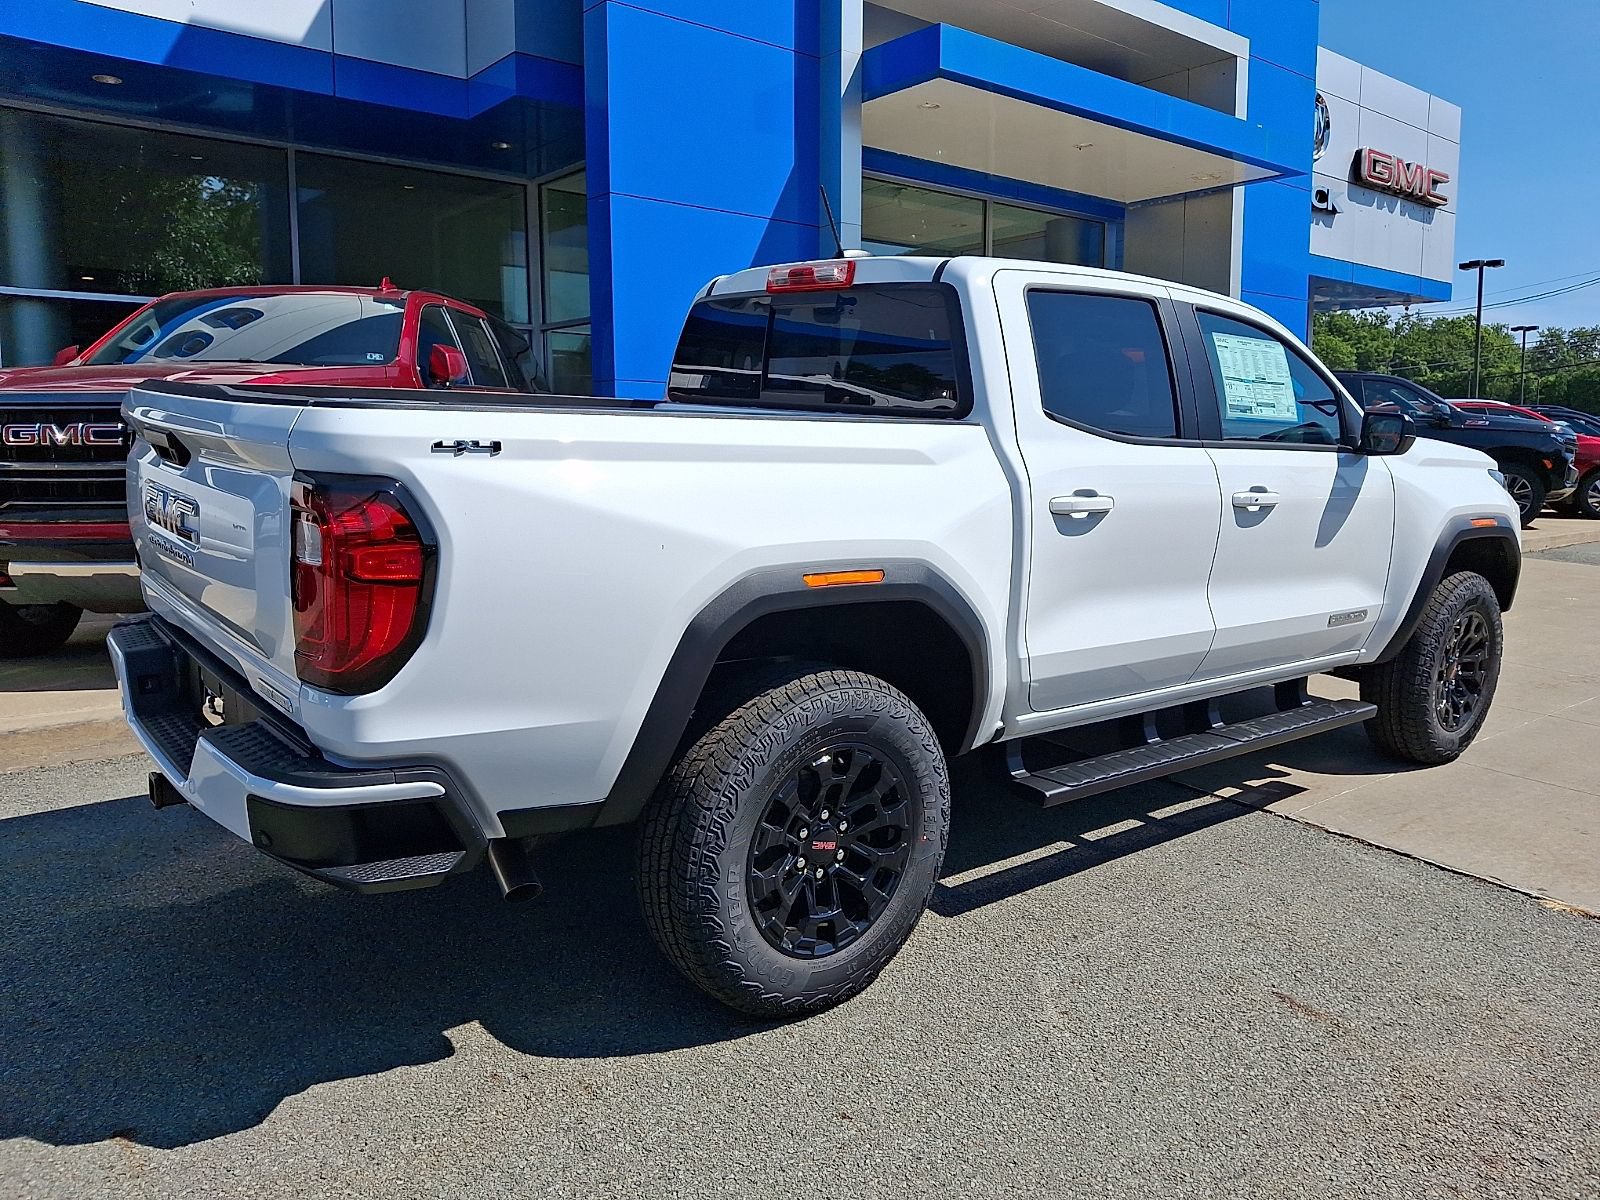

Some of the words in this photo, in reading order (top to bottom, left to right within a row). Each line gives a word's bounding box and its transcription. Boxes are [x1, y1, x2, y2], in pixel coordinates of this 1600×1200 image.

[1360, 146, 1451, 208] GMC
[2, 422, 125, 446] GMC
[145, 485, 200, 546] GMC
[811, 840, 836, 850] GMC
[726, 863, 796, 989] GOODYEAR
